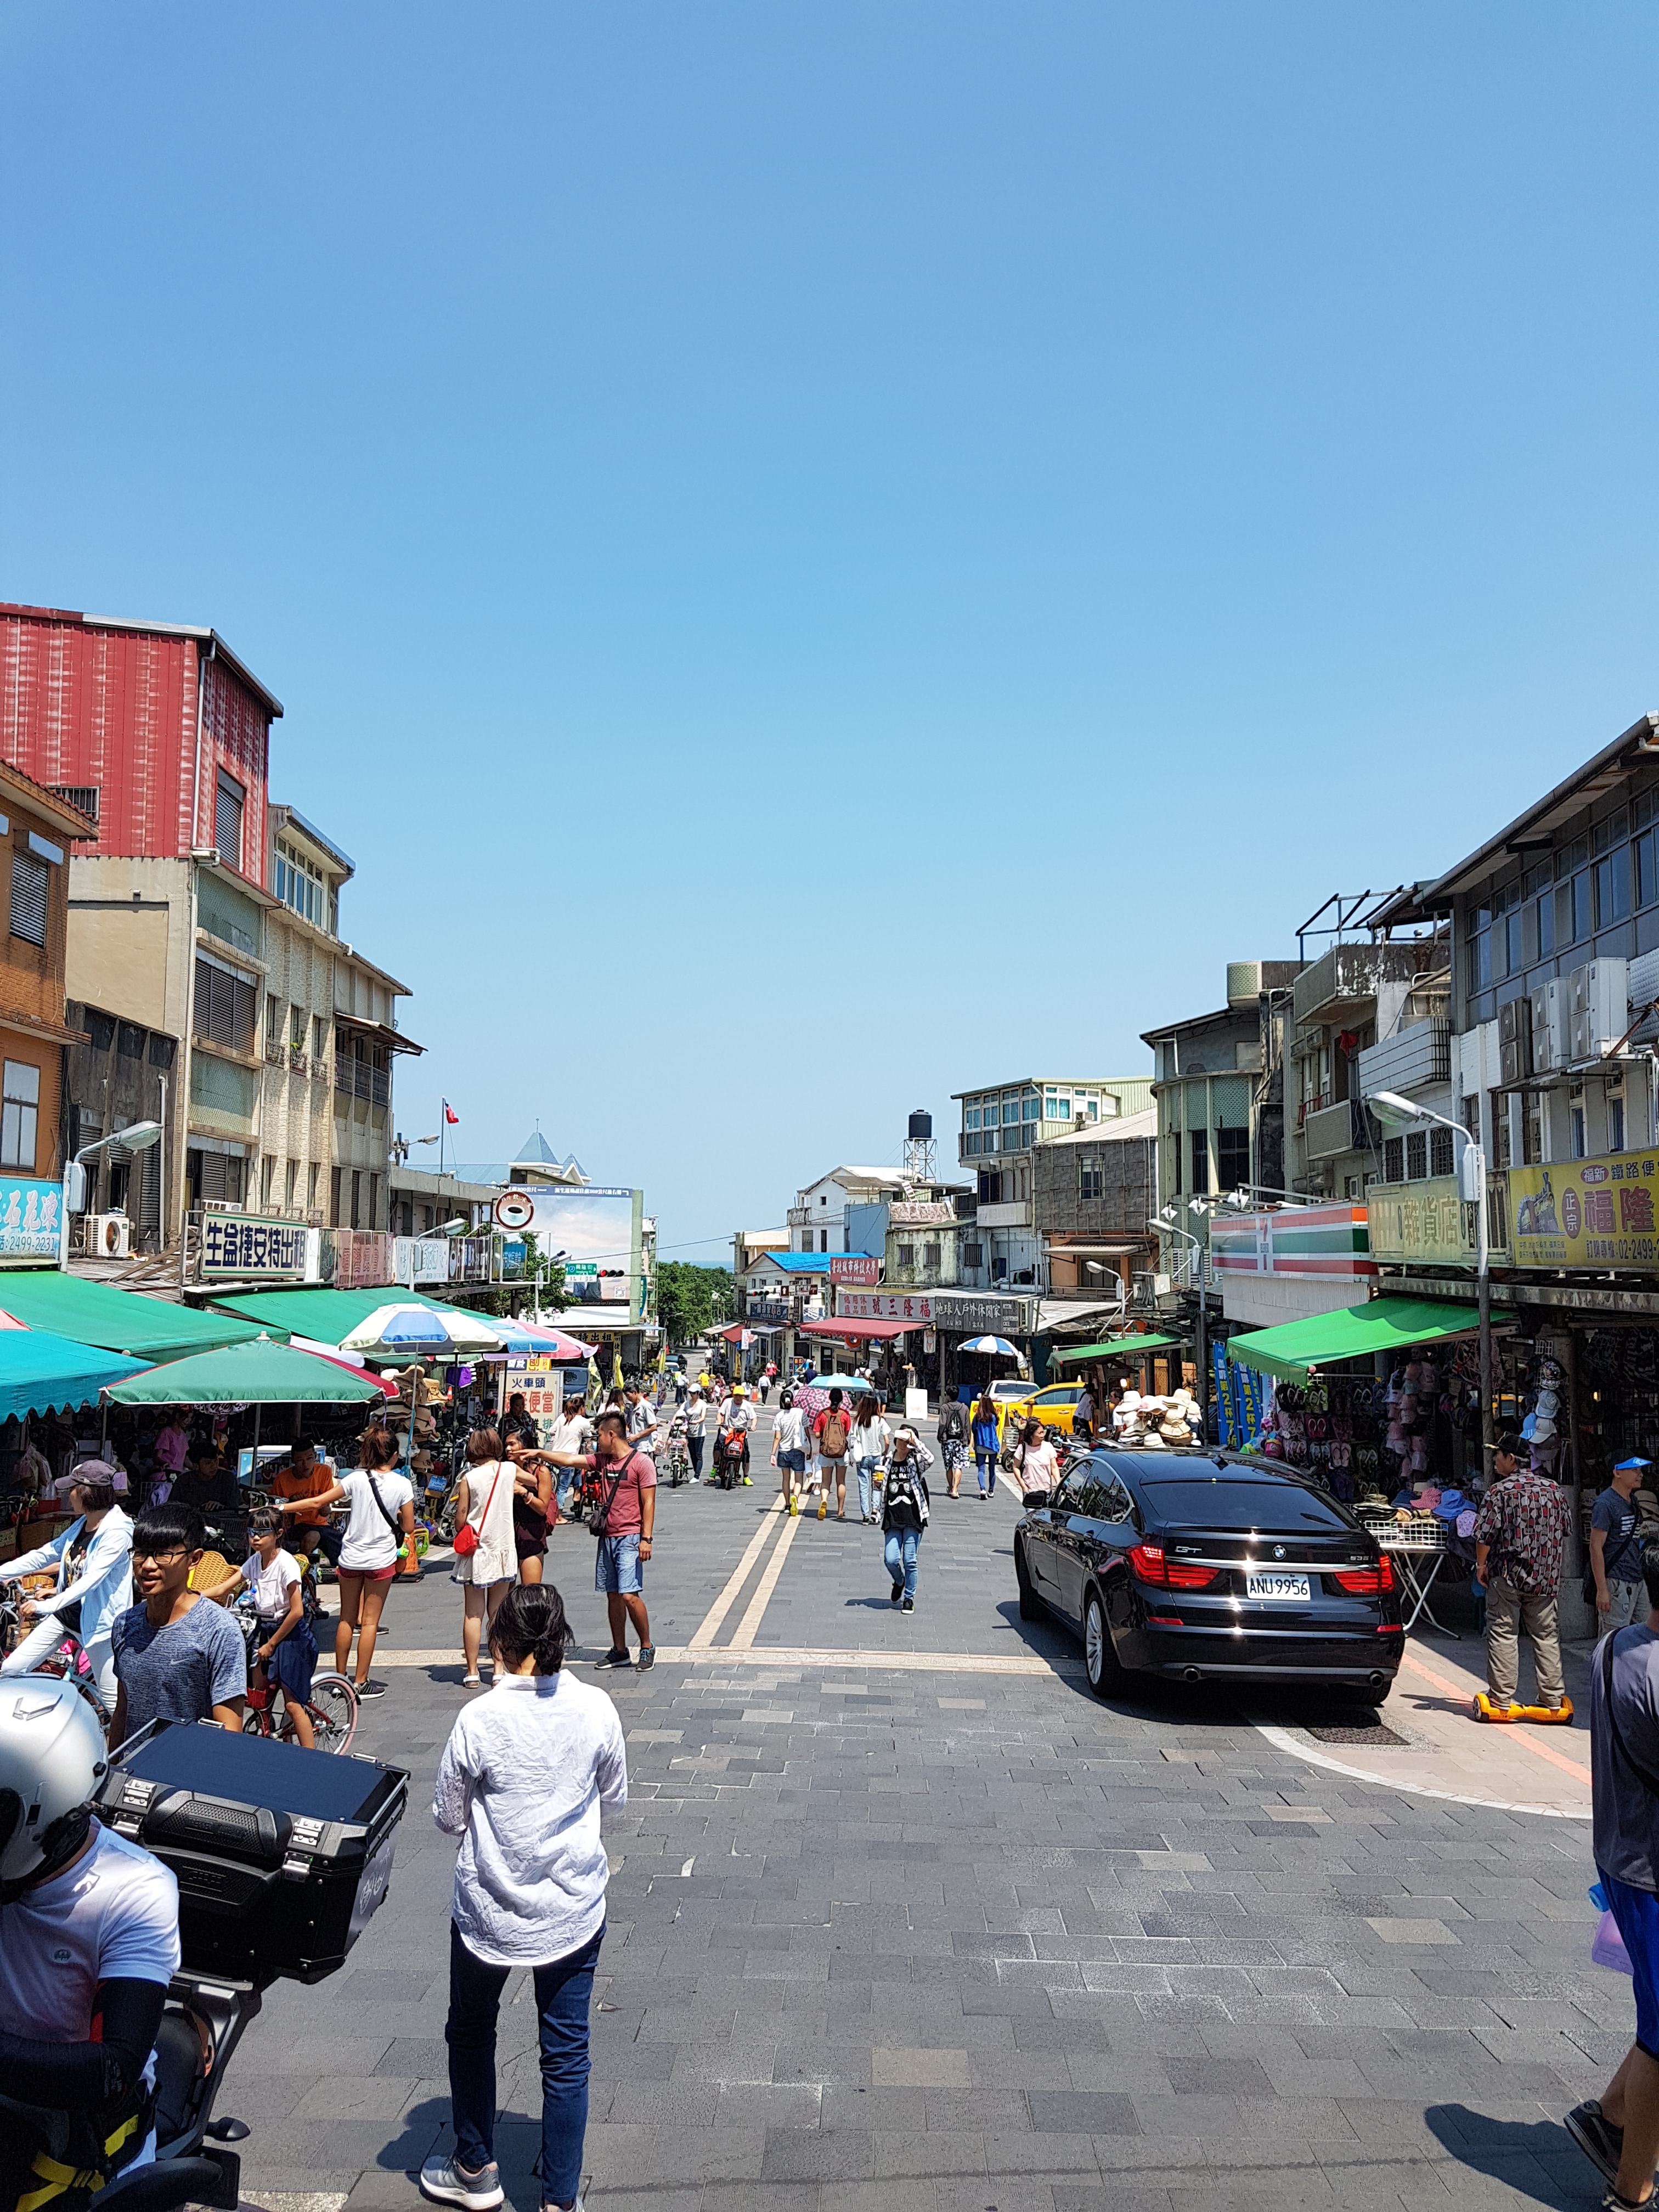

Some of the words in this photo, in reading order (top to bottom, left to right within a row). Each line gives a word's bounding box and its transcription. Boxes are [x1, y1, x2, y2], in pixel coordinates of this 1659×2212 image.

[1583, 1167, 1605, 1182] 福新
[1611, 1160, 1659, 1180] 鐵路便
[0, 1189, 58, 1232] 石花凍
[1404, 1194, 1458, 1247] 雜貨店
[1565, 1193, 1578, 1232] 正宗
[1584, 1186, 1656, 1233] 福隆
[511, 1377, 546, 1389] 火車頭
[1175, 1545, 1202, 1554] GT
